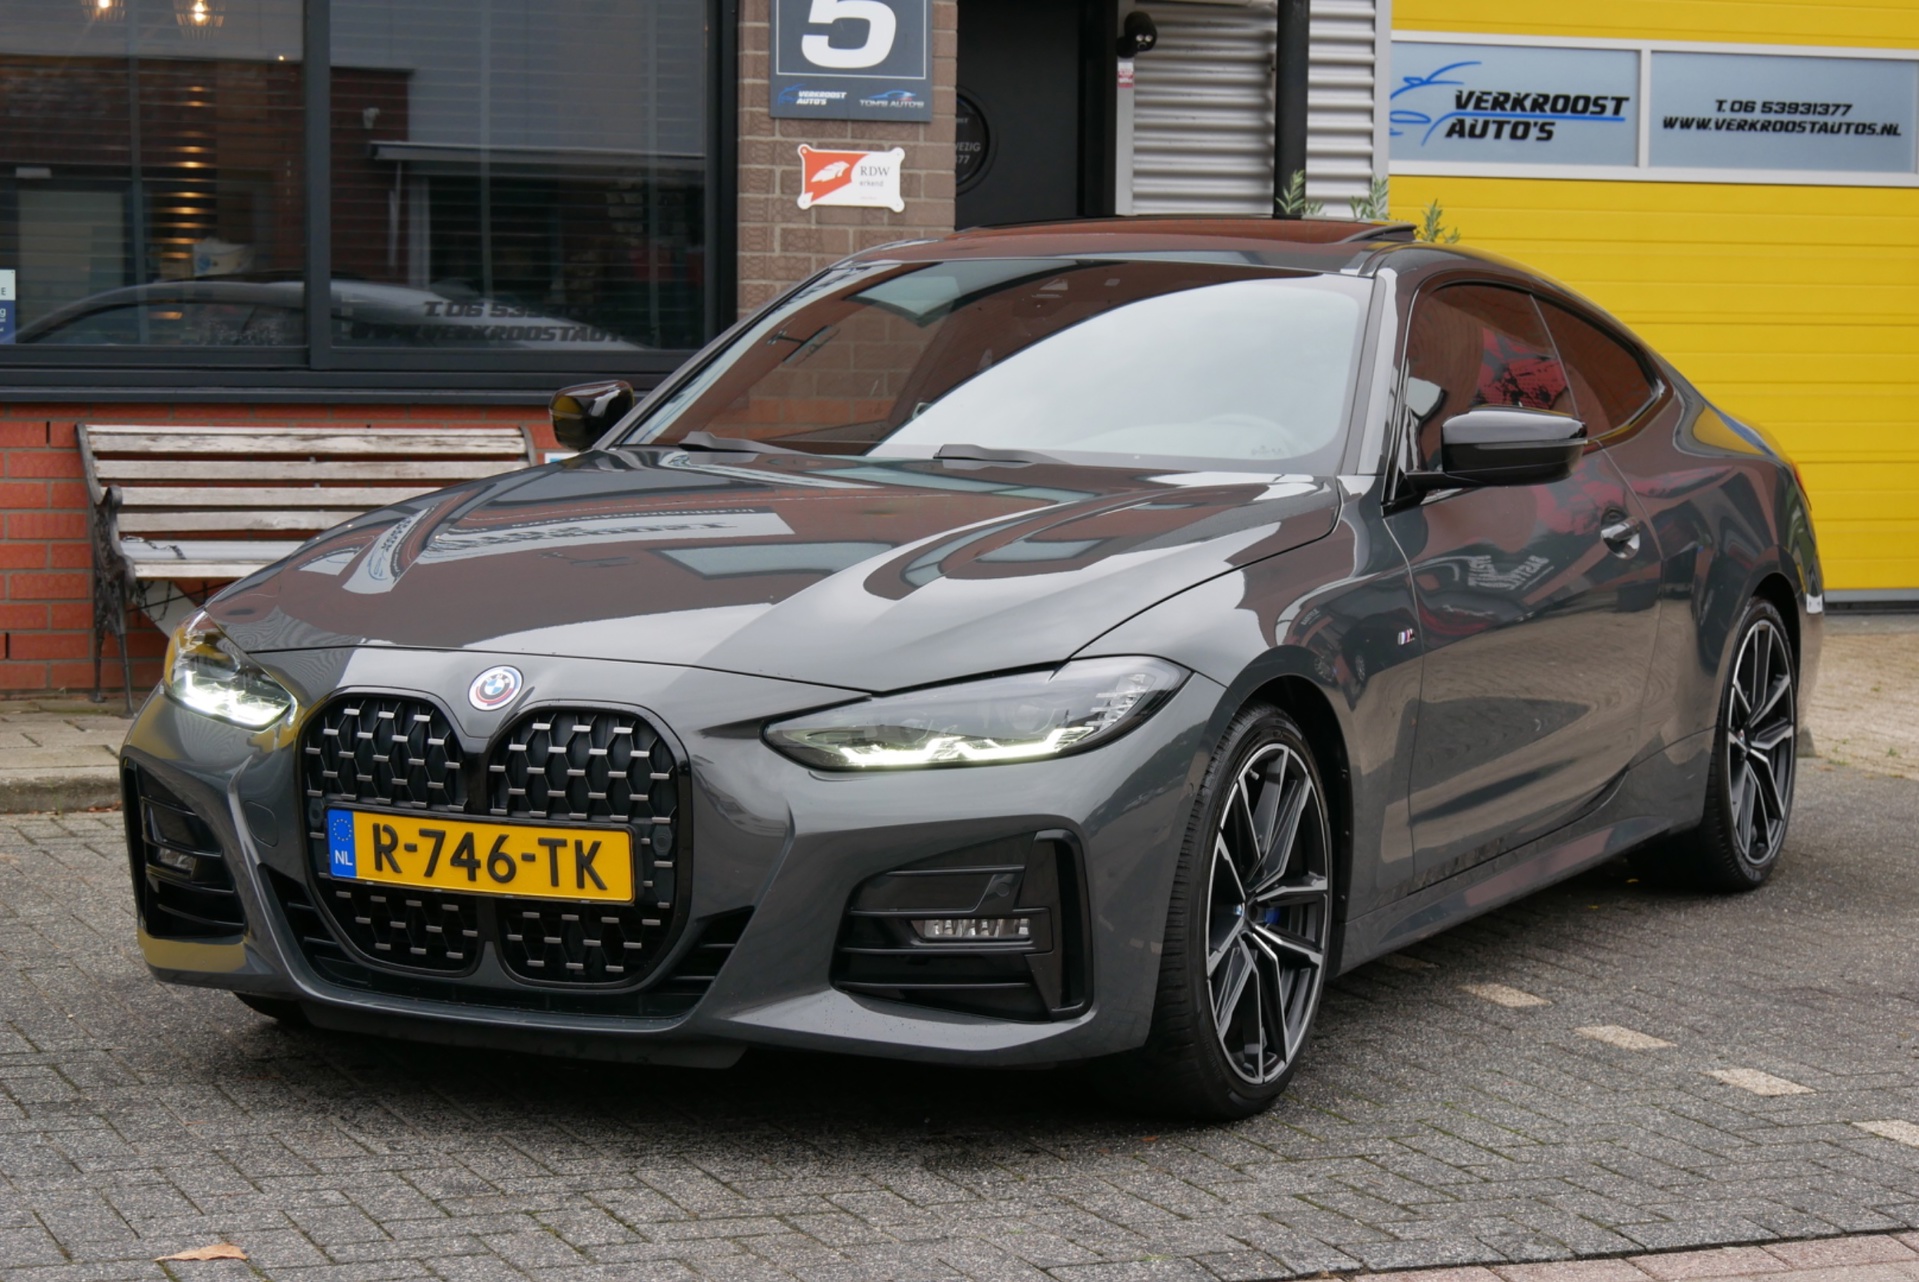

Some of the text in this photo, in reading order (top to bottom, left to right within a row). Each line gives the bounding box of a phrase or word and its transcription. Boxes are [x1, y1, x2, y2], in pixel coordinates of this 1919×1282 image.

[801, 0, 897, 69] 5
[1455, 90, 1630, 116] VERKROOST
[1730, 100, 1756, 113] 06
[1760, 101, 1853, 116] 53931377
[1445, 118, 1556, 141] AUTO'S
[1663, 116, 1902, 136] WWW.VERKROOSTAUTOS.NL
[860, 165, 891, 177] RDW
[335, 850, 353, 866] NL
[372, 823, 607, 890] R-746-TK
